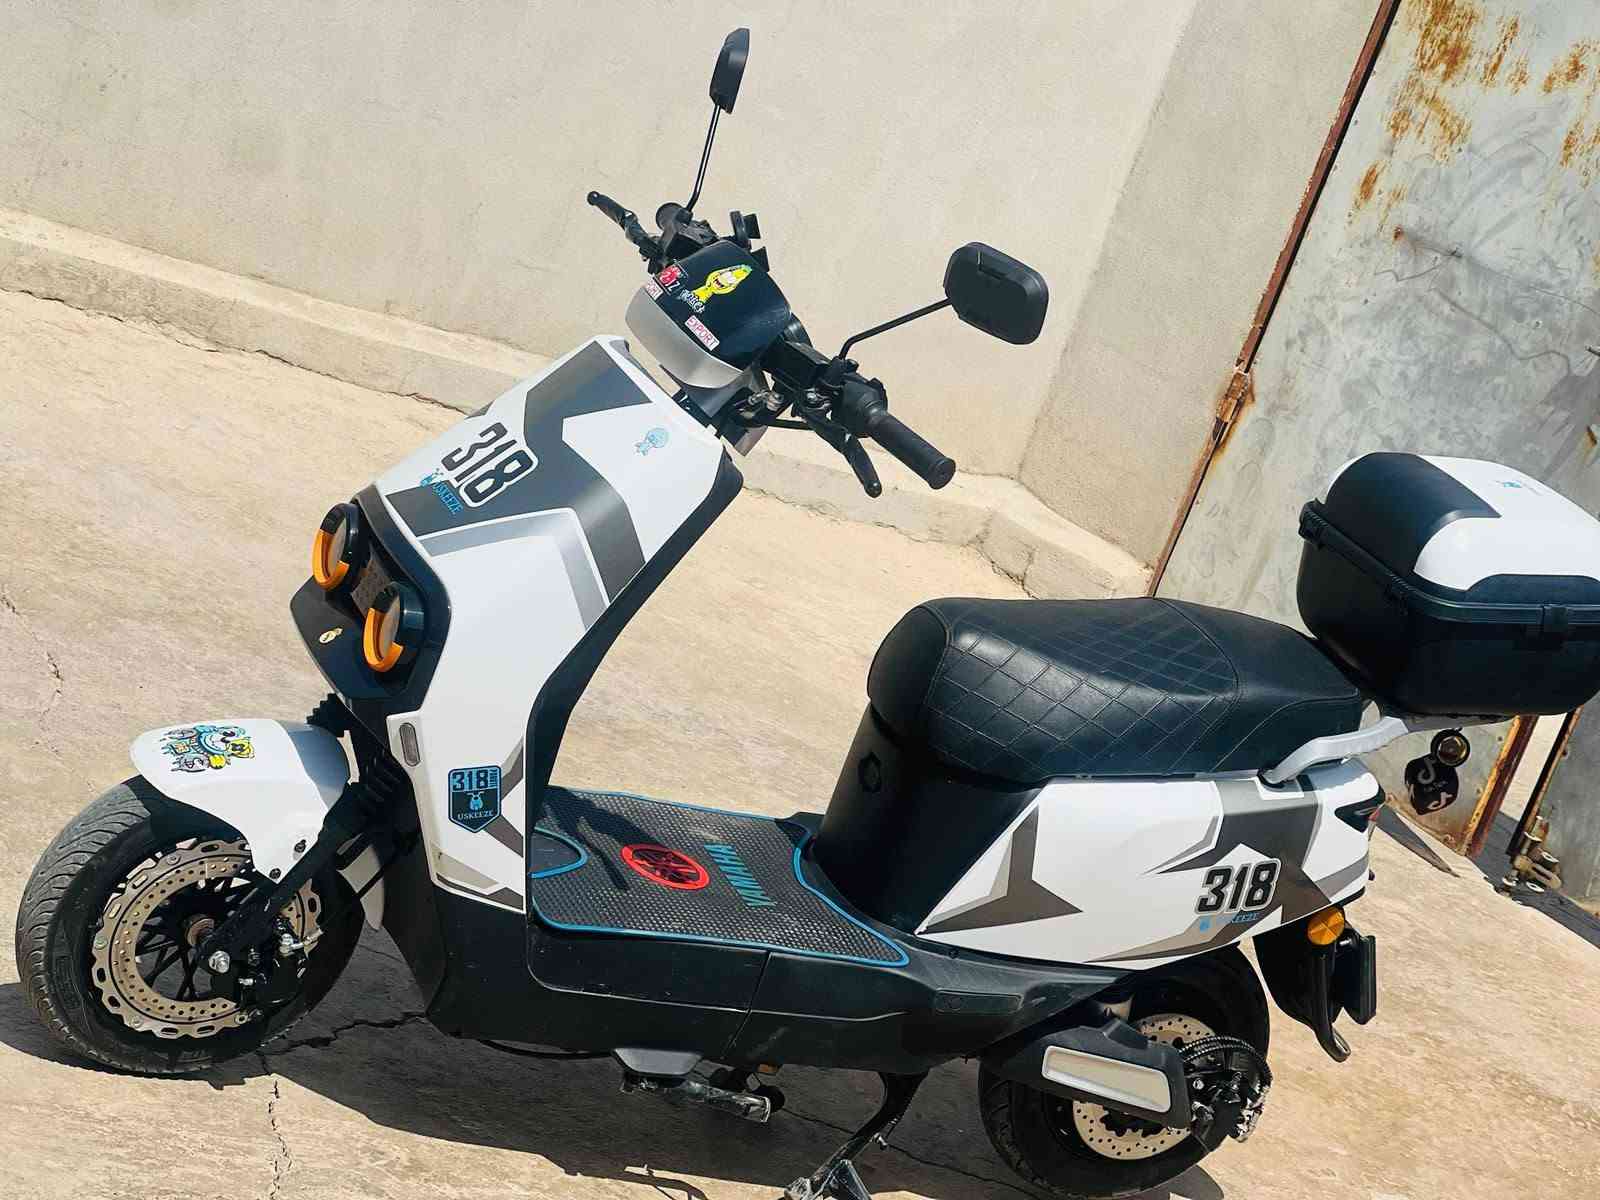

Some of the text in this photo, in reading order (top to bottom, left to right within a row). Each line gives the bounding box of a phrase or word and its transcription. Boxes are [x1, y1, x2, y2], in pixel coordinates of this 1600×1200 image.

[687, 316, 718, 348] EXPORT
[441, 422, 536, 505] 318
[451, 769, 489, 791] 318
[1198, 862, 1278, 912] 318
